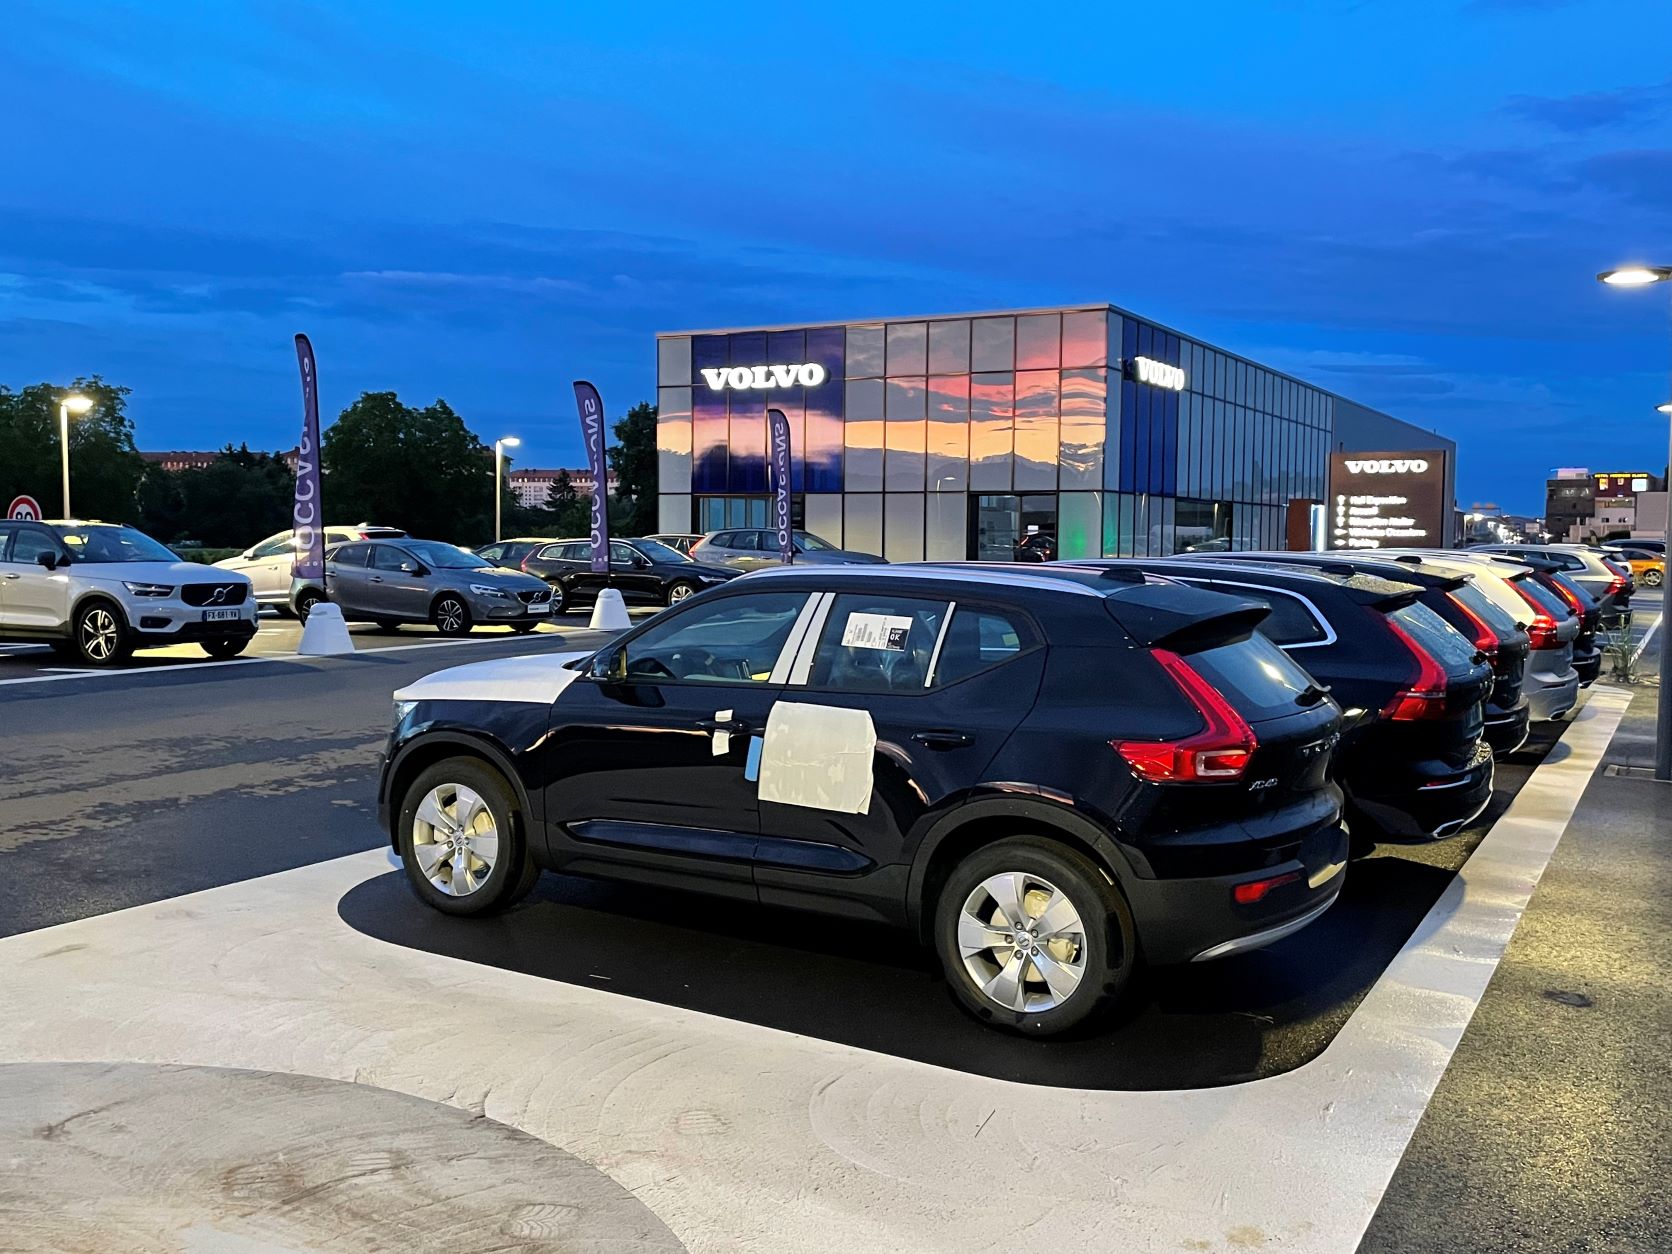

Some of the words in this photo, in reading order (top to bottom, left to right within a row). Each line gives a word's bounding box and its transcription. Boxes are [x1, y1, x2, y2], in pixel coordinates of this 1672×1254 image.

[700, 363, 825, 390] VOLVO
[1135, 356, 1184, 391] VOLVO
[1344, 459, 1429, 474] VOLVO
